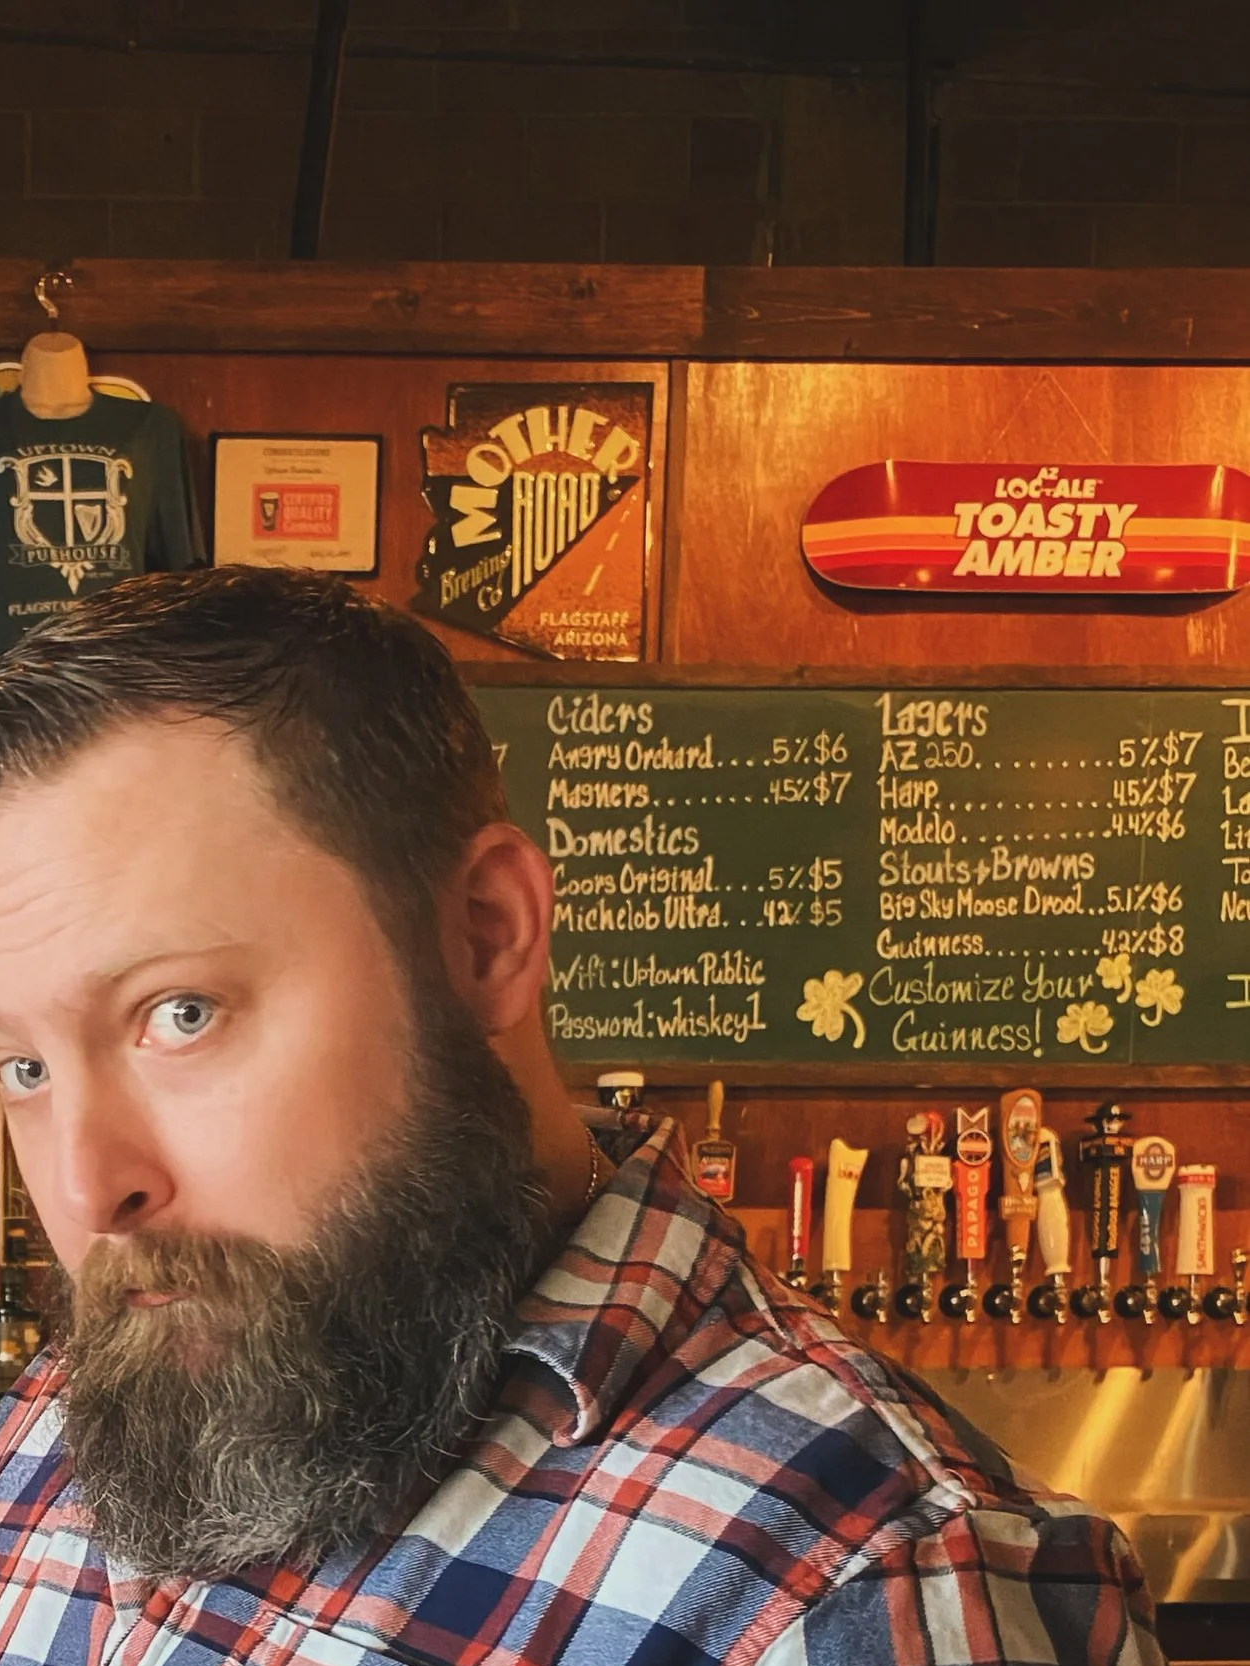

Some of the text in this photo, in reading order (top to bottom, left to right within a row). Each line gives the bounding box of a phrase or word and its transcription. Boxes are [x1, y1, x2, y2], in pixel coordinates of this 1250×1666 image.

[17, 444, 117, 456] UPTOWN
[450, 405, 640, 548] MOTHER
[1039, 467, 1059, 480] AZ
[511, 472, 601, 598] ROAD
[953, 503, 1138, 538] TOASTY
[27, 545, 118, 563] PUBHOUSE
[953, 541, 1127, 577] AMBER
[439, 545, 512, 609] Brewing
[539, 612, 630, 628] FLAGSTAFF
[553, 630, 630, 647] ARIZONA
[546, 693, 654, 736] Ciders
[875, 692, 990, 738] Lagers
[547, 740, 620, 771] Angry
[624, 733, 715, 771] Orchard
[878, 741, 920, 773] AZ
[924, 742, 974, 769] 250
[547, 777, 650, 811] Magners
[876, 775, 939, 810] Harp
[545, 813, 700, 858] Domestics
[878, 812, 956, 846] Modelo
[552, 862, 616, 896] Coors
[619, 856, 715, 895] Original
[878, 848, 971, 886] Stouts
[991, 845, 1096, 882] Browns
[551, 899, 661, 932] Michelob
[663, 897, 722, 930] Ultra
[879, 892, 917, 921] Big
[919, 887, 954, 920] Sky
[956, 887, 1019, 919] Moose
[1022, 882, 1085, 916] Drool
[876, 926, 984, 960] Guinness
[622, 953, 699, 988] Uptown
[697, 949, 767, 987] Public
[868, 959, 1095, 1006] Customize Your
[892, 1008, 1044, 1058] Guinness!
[1139, 1155, 1171, 1167] HARP
[966, 1171, 980, 1248] PAPAGO
